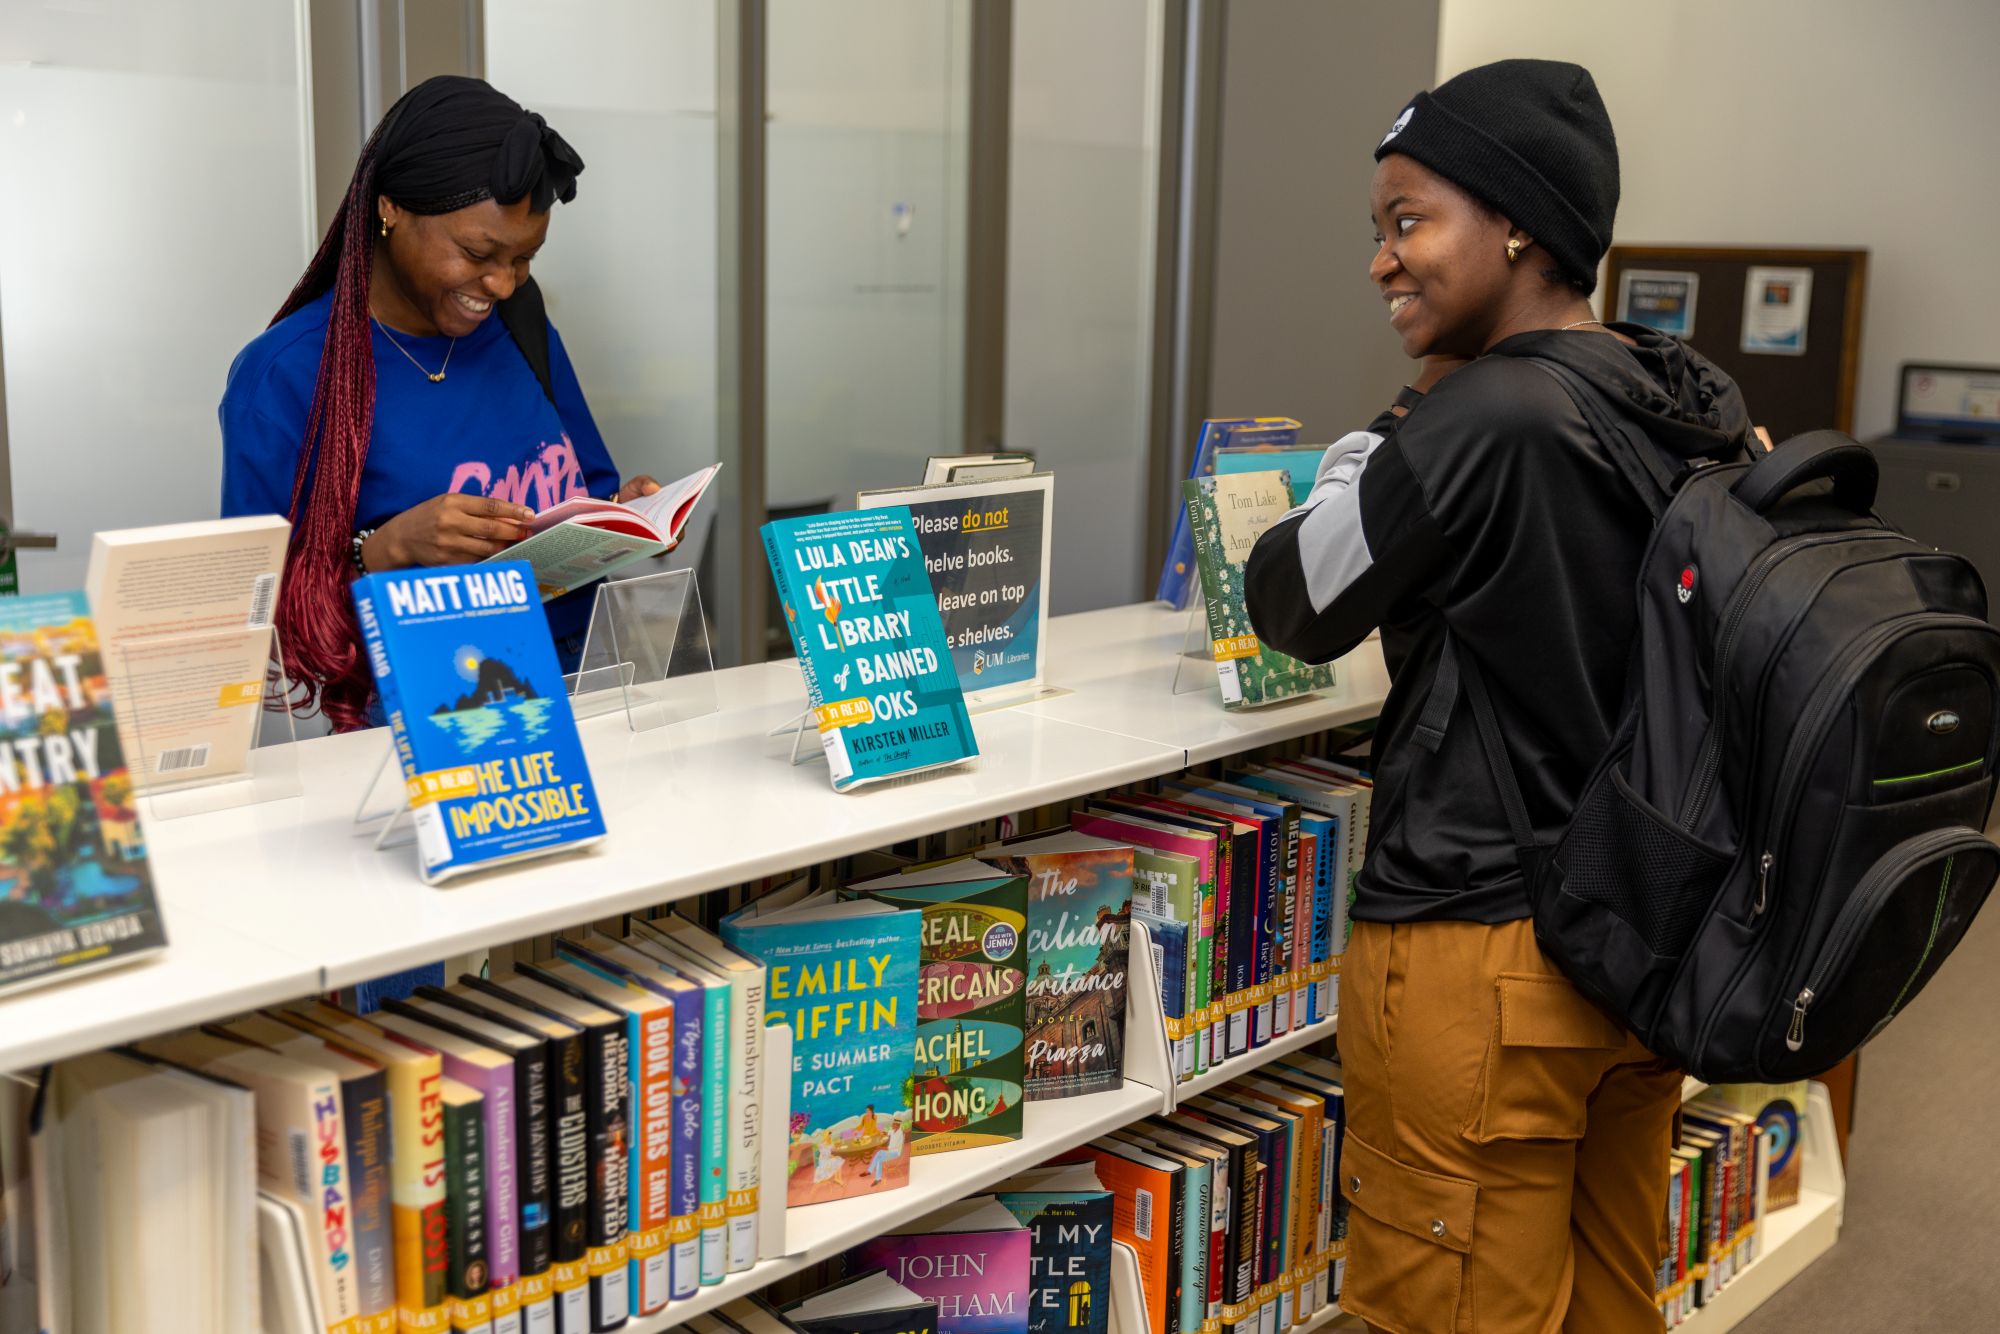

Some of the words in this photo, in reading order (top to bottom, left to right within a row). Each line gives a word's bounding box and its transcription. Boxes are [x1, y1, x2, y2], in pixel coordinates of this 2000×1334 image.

[1187, 496, 1201, 528] Tom
[1228, 493, 1253, 509] Tom
[1254, 490, 1277, 507] Lake
[912, 515, 959, 534] Please
[962, 510, 982, 530] do
[985, 507, 1009, 527] not
[795, 543, 847, 572] LULA
[849, 536, 910, 565] DEAN'S
[968, 545, 1014, 567] books.
[1192, 528, 1205, 555] Lake
[1230, 533, 1251, 551] Ann
[386, 574, 462, 617] MATT
[464, 569, 528, 608] HAIG
[776, 568, 788, 595] MILLER
[805, 574, 883, 611] LITTLE
[939, 592, 977, 613] leave
[980, 588, 998, 606] on
[1001, 584, 1026, 606] top
[358, 597, 381, 639] MATT
[1208, 596, 1218, 621] Ann
[958, 624, 1014, 650] shelves.
[1238, 637, 1258, 650] READ
[369, 640, 392, 678] HAIG
[833, 663, 851, 692] of
[856, 646, 938, 685] BANNED
[986, 652, 1004, 668] UM
[1007, 651, 1030, 665] Libraries
[840, 700, 869, 717] READ
[852, 727, 908, 754] KIRSTEN
[910, 721, 950, 743] MILLER
[439, 770, 475, 790] READ
[510, 751, 562, 790] LIFE
[449, 783, 590, 840] IMPOSSIBLE
[1348, 802, 1357, 844] CELESTE
[1269, 831, 1279, 863] JOJO
[1286, 819, 1300, 869] HELLO
[1305, 846, 1313, 873] ONLY
[1036, 868, 1079, 902] The
[1206, 849, 1215, 907] MONAGHAN
[1267, 865, 1278, 910] MOYES
[1303, 875, 1312, 914] SISTERS
[920, 915, 976, 946] REAL
[1282, 875, 1297, 960] BEAUTIFUL
[835, 936, 875, 949] bestselling
[877, 935, 900, 945] author
[985, 937, 1014, 949] JENNA
[1260, 942, 1270, 969] Else's
[771, 954, 892, 1000] EMILY
[1037, 1014, 1085, 1026] NOVEL
[645, 1015, 671, 1079] BOOK
[680, 1016, 702, 1072] Flying
[712, 1013, 725, 1069] FORTUNES
[738, 985, 761, 1098] Bloomsbury
[811, 1043, 892, 1072] SUMMER
[915, 1029, 991, 1064] ACHEL
[1028, 1039, 1108, 1070] Piazza
[603, 1032, 620, 1114] HENDRIX
[615, 1037, 629, 1100] GRADY
[803, 1074, 854, 1098] PACT
[495, 1085, 509, 1098] A
[527, 1060, 545, 1117] PAULA
[712, 1081, 724, 1117] JADED
[915, 1086, 987, 1123] HONG
[419, 1072, 445, 1148] LESS
[646, 1080, 671, 1163] LOVERS
[680, 1098, 701, 1142] Solo
[742, 1102, 760, 1149] Girls
[497, 1098, 512, 1168] Hundred
[711, 1118, 723, 1158] WOMEN
[422, 1157, 446, 1188] IS
[529, 1120, 547, 1195] HAWKINS
[559, 1110, 588, 1210] CLOISTERS
[616, 1155, 629, 1197] HOW
[682, 1153, 695, 1191] LINDA
[1241, 1150, 1259, 1193] JAMES
[1310, 1148, 1320, 1178] MAD
[313, 1094, 350, 1272] HUSBANDS
[498, 1171, 512, 1220] Other
[603, 1146, 620, 1236] HAUNTED
[645, 1170, 668, 1221] EMILY
[465, 1153, 482, 1254] EMPRESS
[1198, 1183, 1209, 1247] Otherwise
[1307, 1185, 1319, 1238] HONEY
[423, 1198, 450, 1274] LOST
[499, 1222, 512, 1264] Girls
[1058, 1224, 1103, 1244] MY
[1239, 1193, 1256, 1262] PATTERSON
[898, 1253, 988, 1285] JOHN
[1236, 1259, 1252, 1304] COUNT
